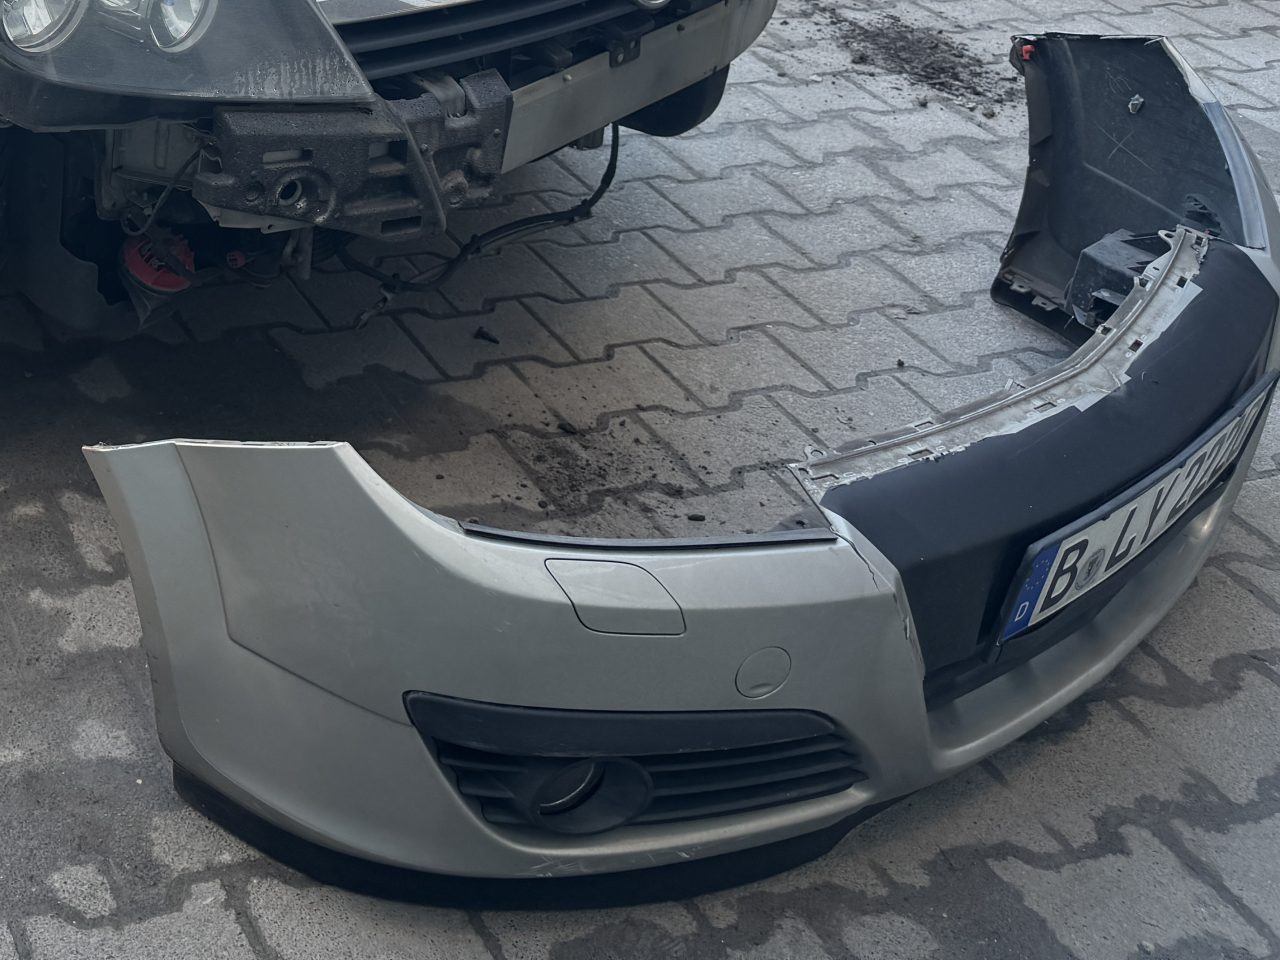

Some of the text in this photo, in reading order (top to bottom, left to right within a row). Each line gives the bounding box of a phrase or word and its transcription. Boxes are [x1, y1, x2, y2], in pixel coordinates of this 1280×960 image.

[1038, 538, 1089, 614] B
[1104, 473, 1182, 573] LY
[1014, 601, 1029, 622] D
